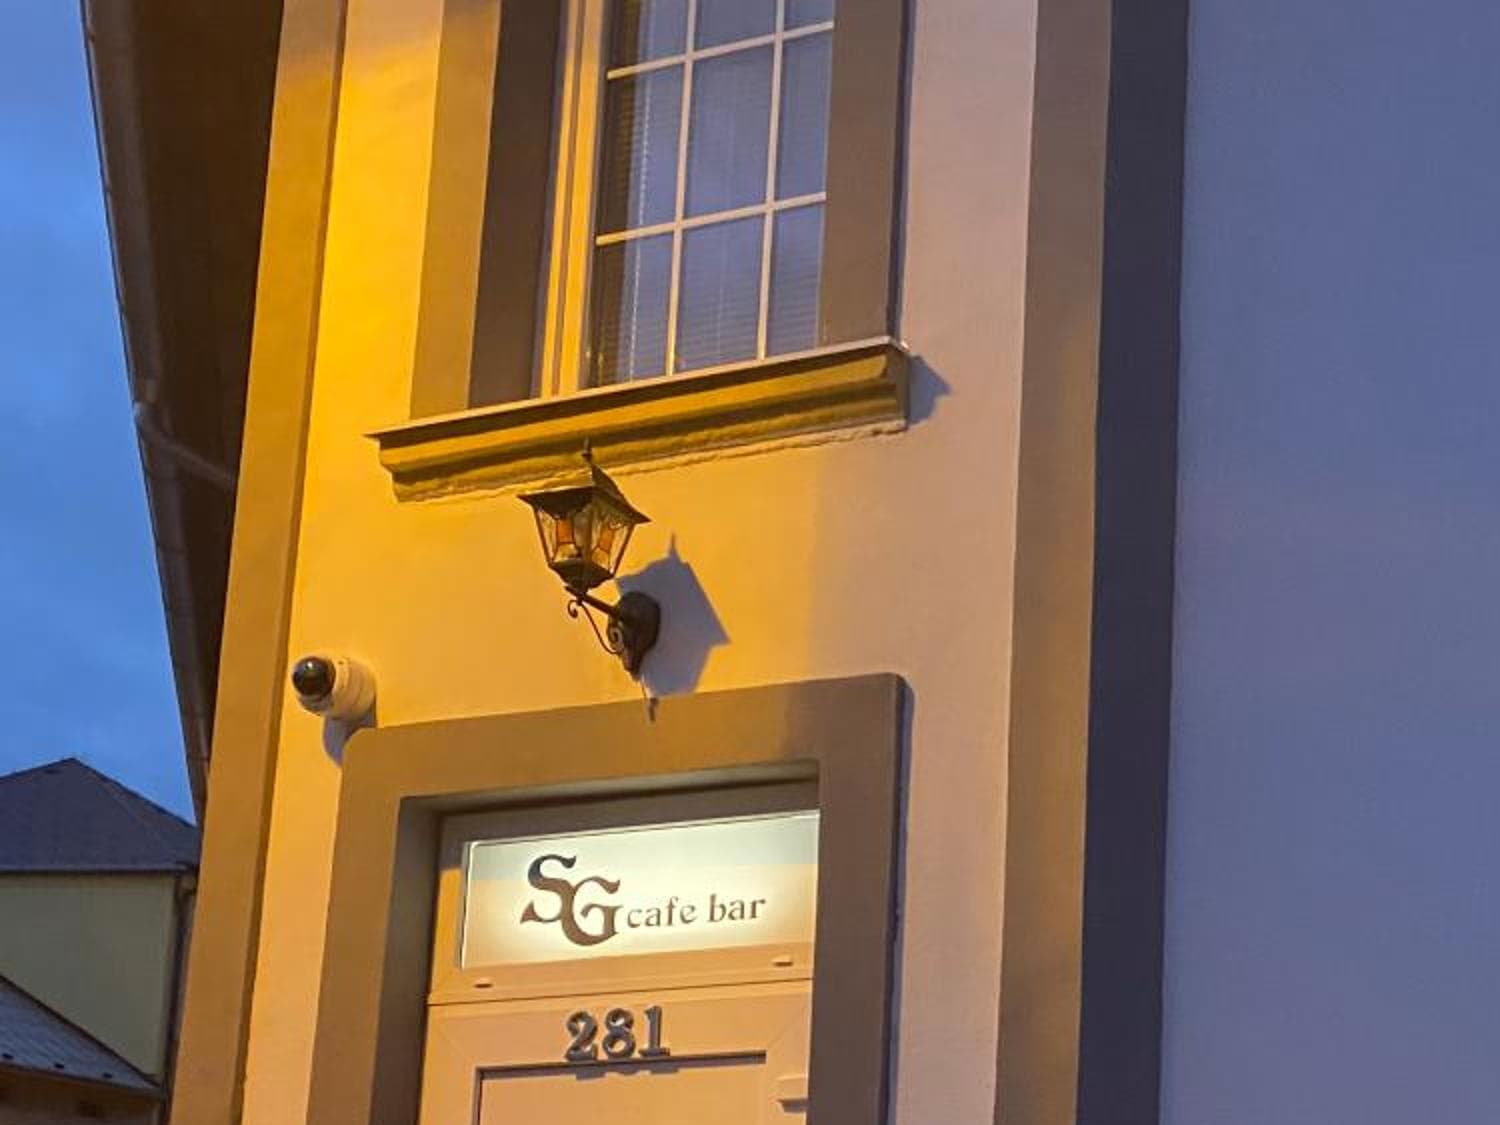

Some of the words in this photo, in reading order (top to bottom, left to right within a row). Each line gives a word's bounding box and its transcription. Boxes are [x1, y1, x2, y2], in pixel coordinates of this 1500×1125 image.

[519, 853, 624, 947] SG
[626, 896, 698, 929] cafe
[708, 893, 767, 923] bar
[564, 1005, 671, 1064] 281
